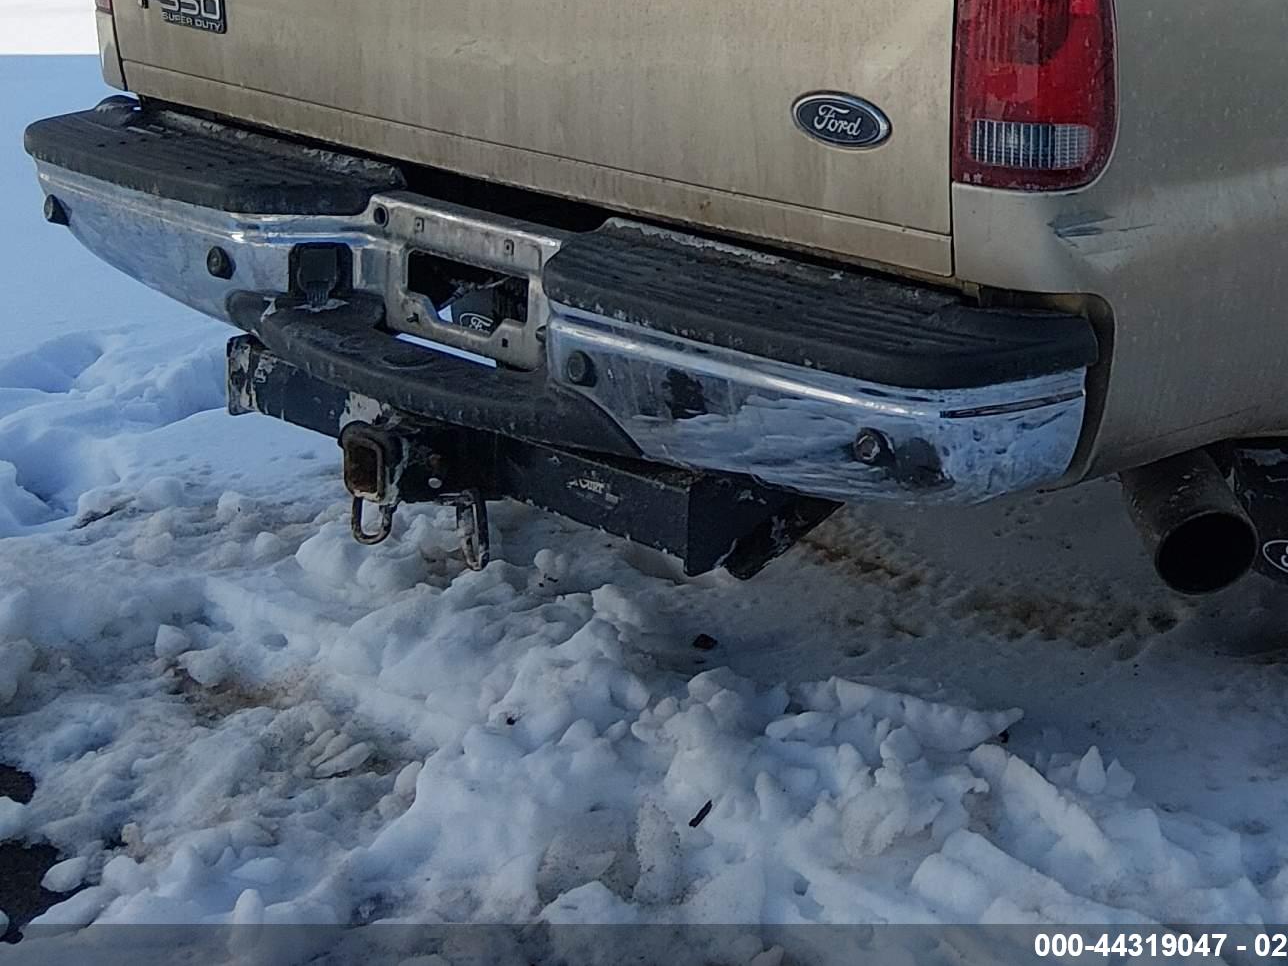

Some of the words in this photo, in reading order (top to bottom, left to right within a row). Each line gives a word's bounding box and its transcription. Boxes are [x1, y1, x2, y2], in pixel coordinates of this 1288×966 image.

[161, 11, 193, 26] SUPER
[195, 18, 222, 32] DUTY
[813, 104, 862, 136] Ford
